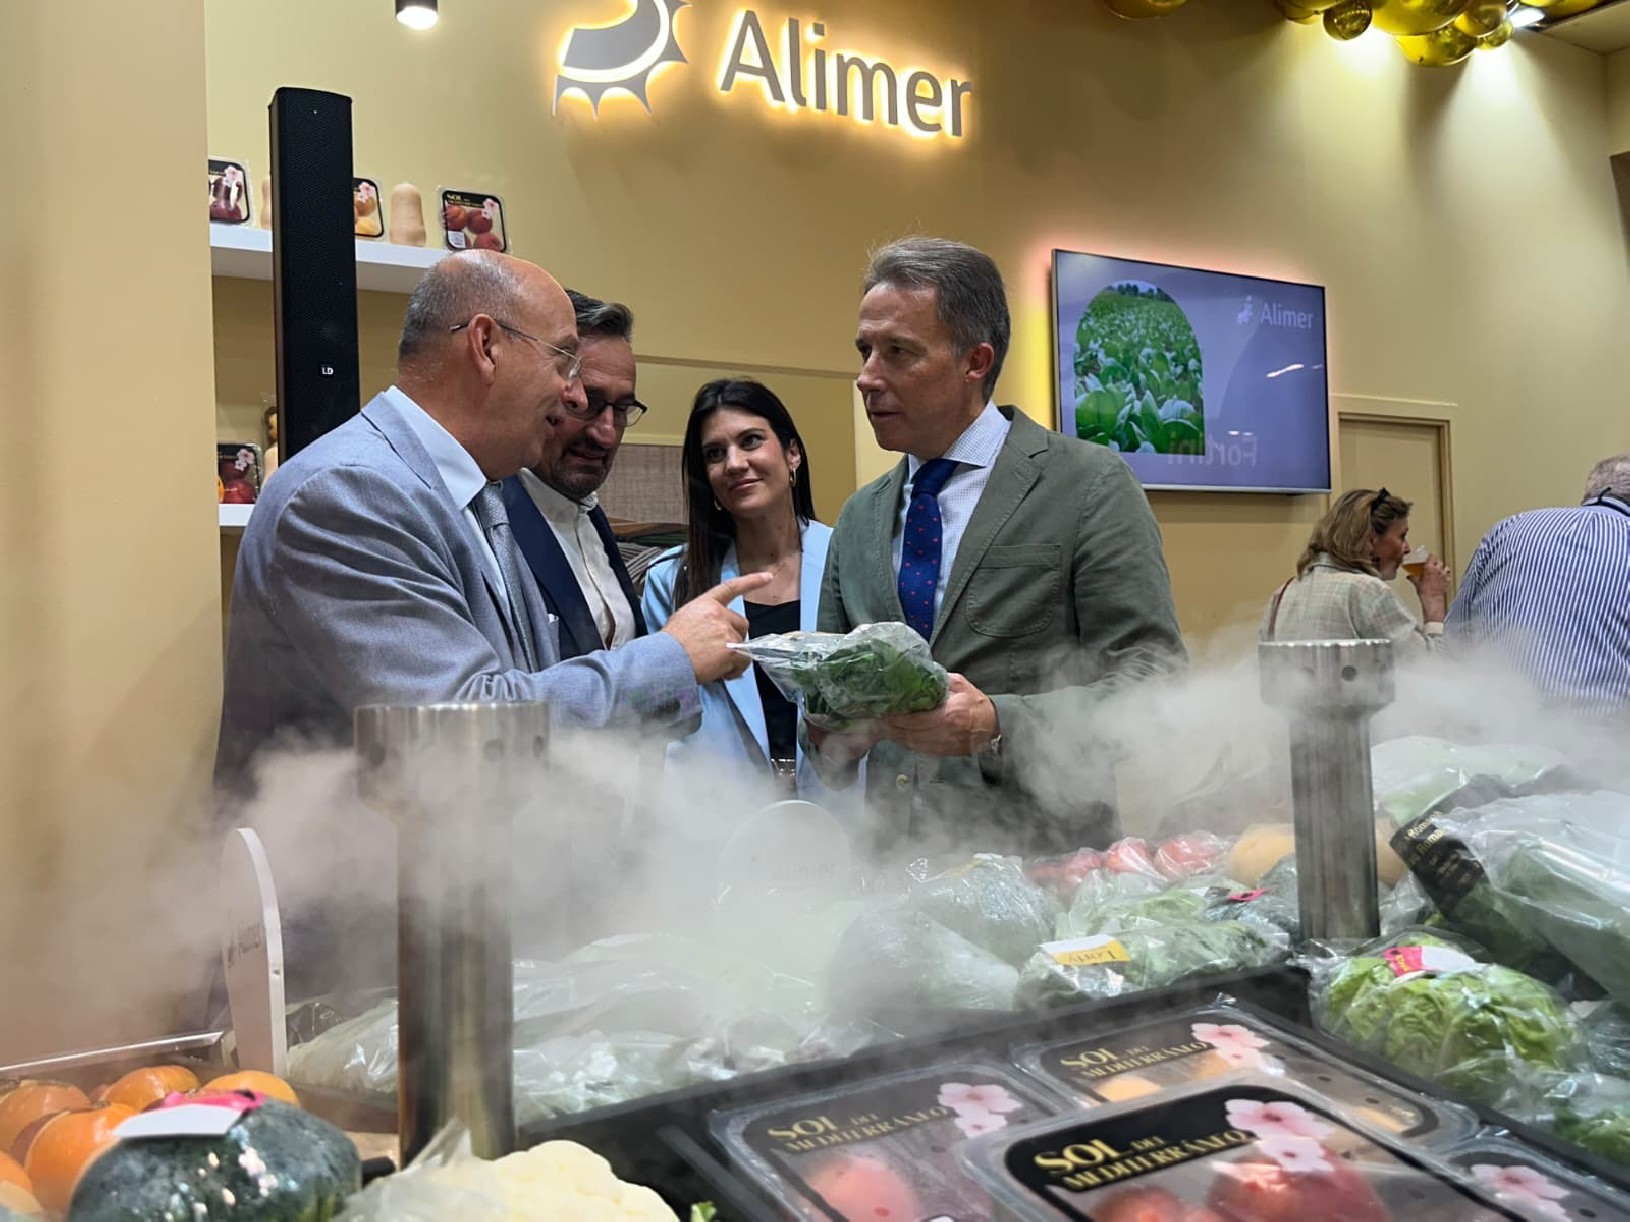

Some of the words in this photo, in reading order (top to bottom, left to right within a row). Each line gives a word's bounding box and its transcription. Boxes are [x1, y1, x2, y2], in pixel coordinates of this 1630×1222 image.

[719, 9, 972, 137] Alimer
[1259, 302, 1314, 329] Alimer
[1060, 1047, 1121, 1069] SOL
[767, 1115, 839, 1141] SOL
[1034, 1138, 1125, 1175] SOL
